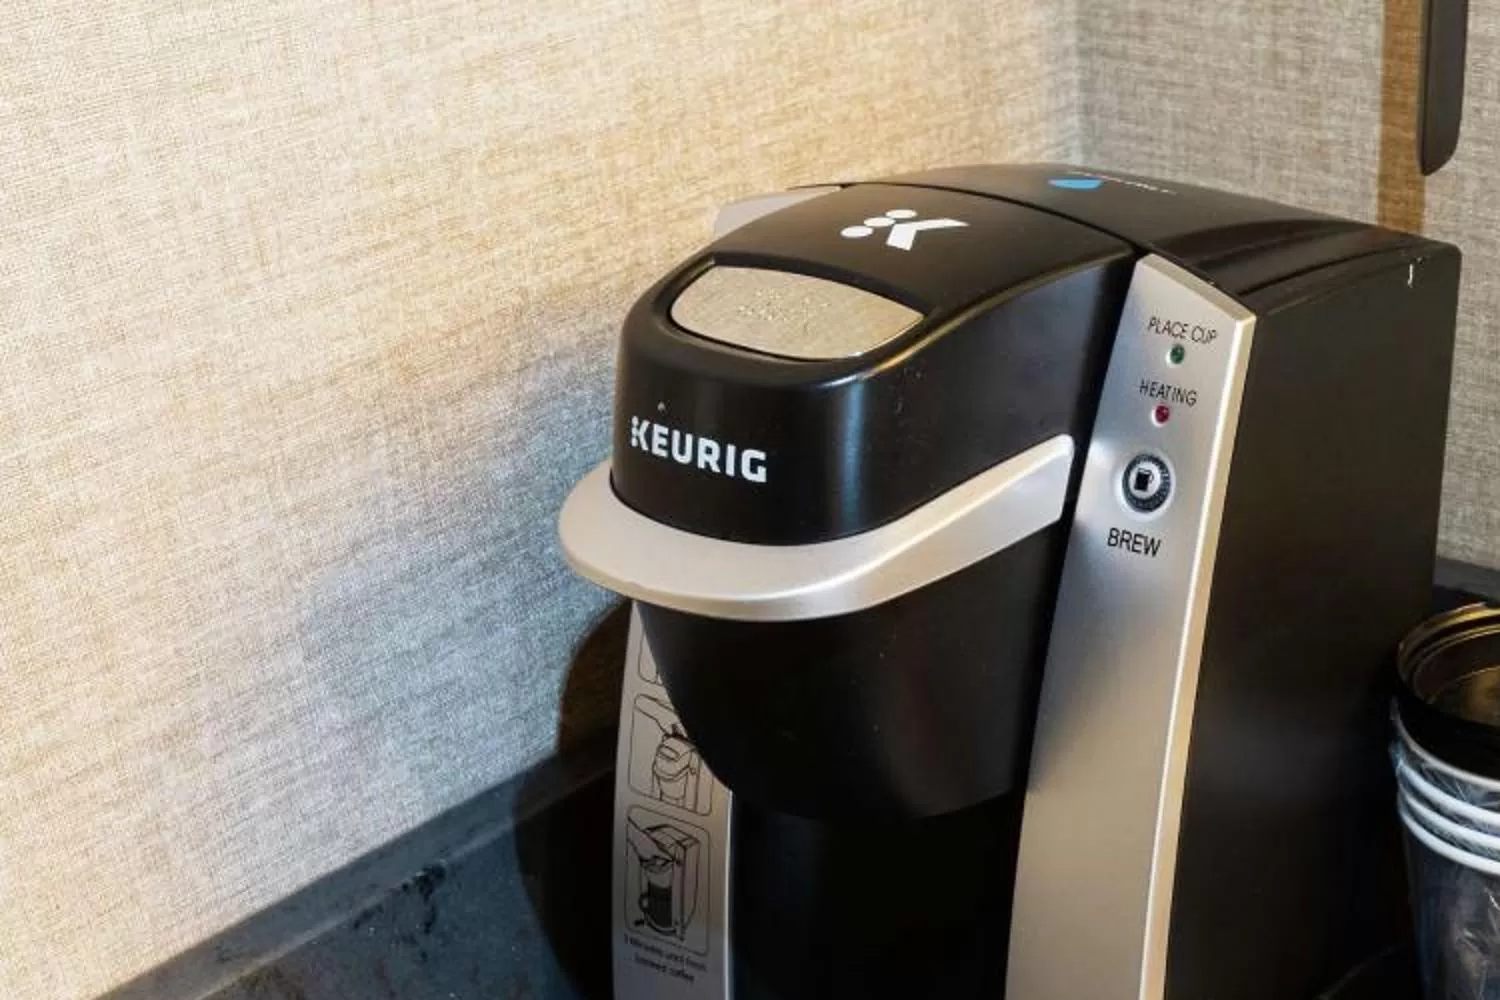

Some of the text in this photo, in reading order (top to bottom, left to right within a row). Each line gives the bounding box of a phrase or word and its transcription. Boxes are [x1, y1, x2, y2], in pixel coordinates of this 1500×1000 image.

[1148, 316, 1218, 345] PLACE CUP
[1140, 379, 1198, 407] HEATING
[630, 416, 768, 484] KEURIG
[1107, 527, 1161, 558] BREW
